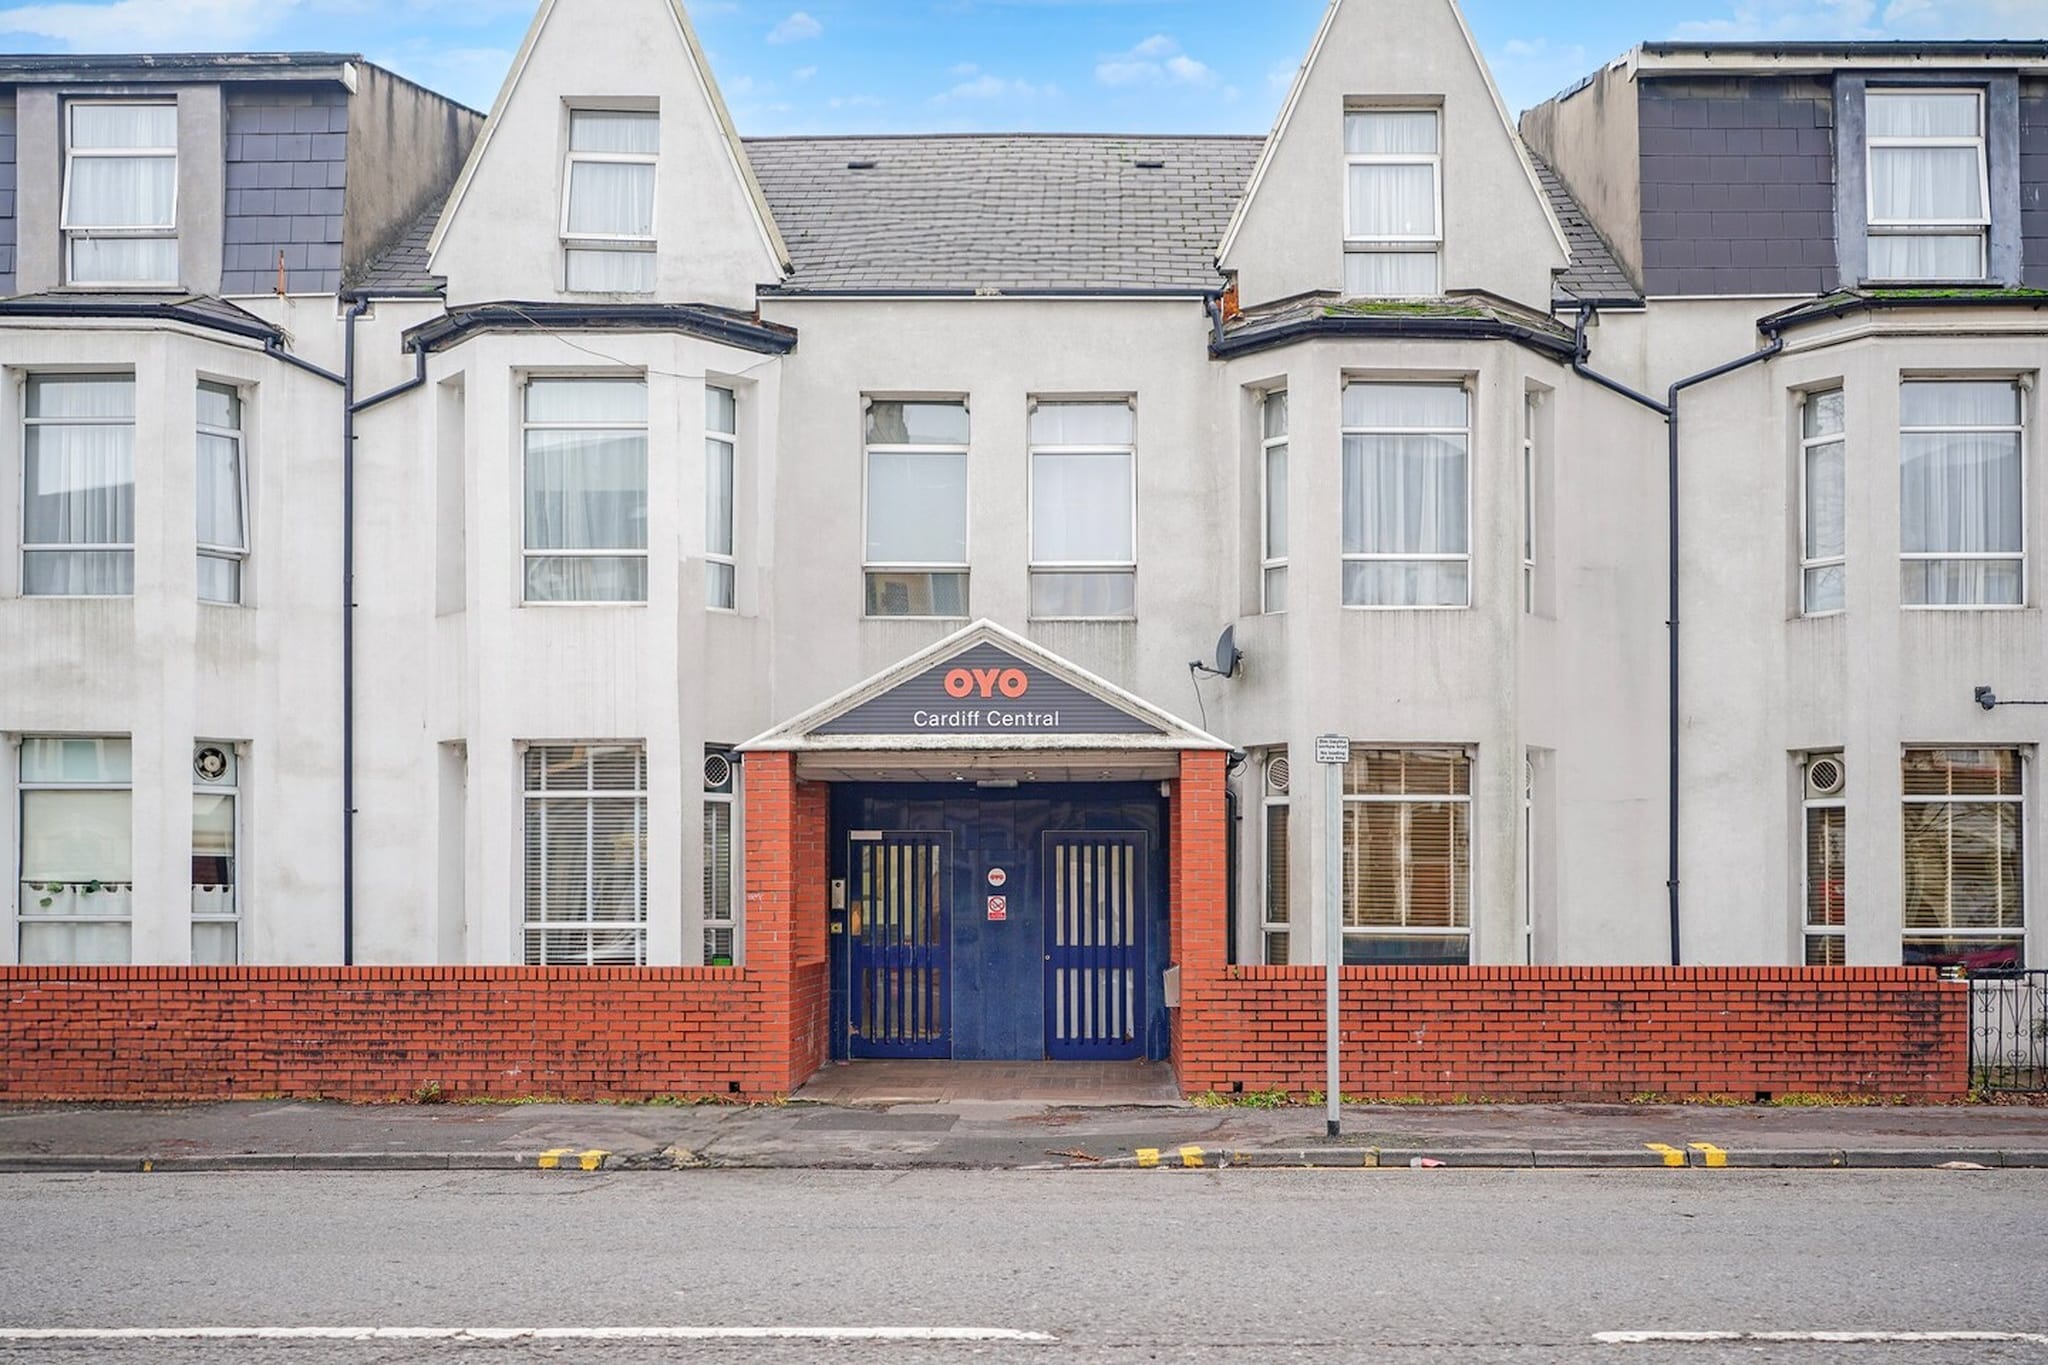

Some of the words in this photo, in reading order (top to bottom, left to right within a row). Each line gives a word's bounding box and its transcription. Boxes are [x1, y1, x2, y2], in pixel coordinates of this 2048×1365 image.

[944, 668, 1028, 698] OYO
[913, 711, 980, 727] Cardiff
[987, 711, 1060, 727] Central
